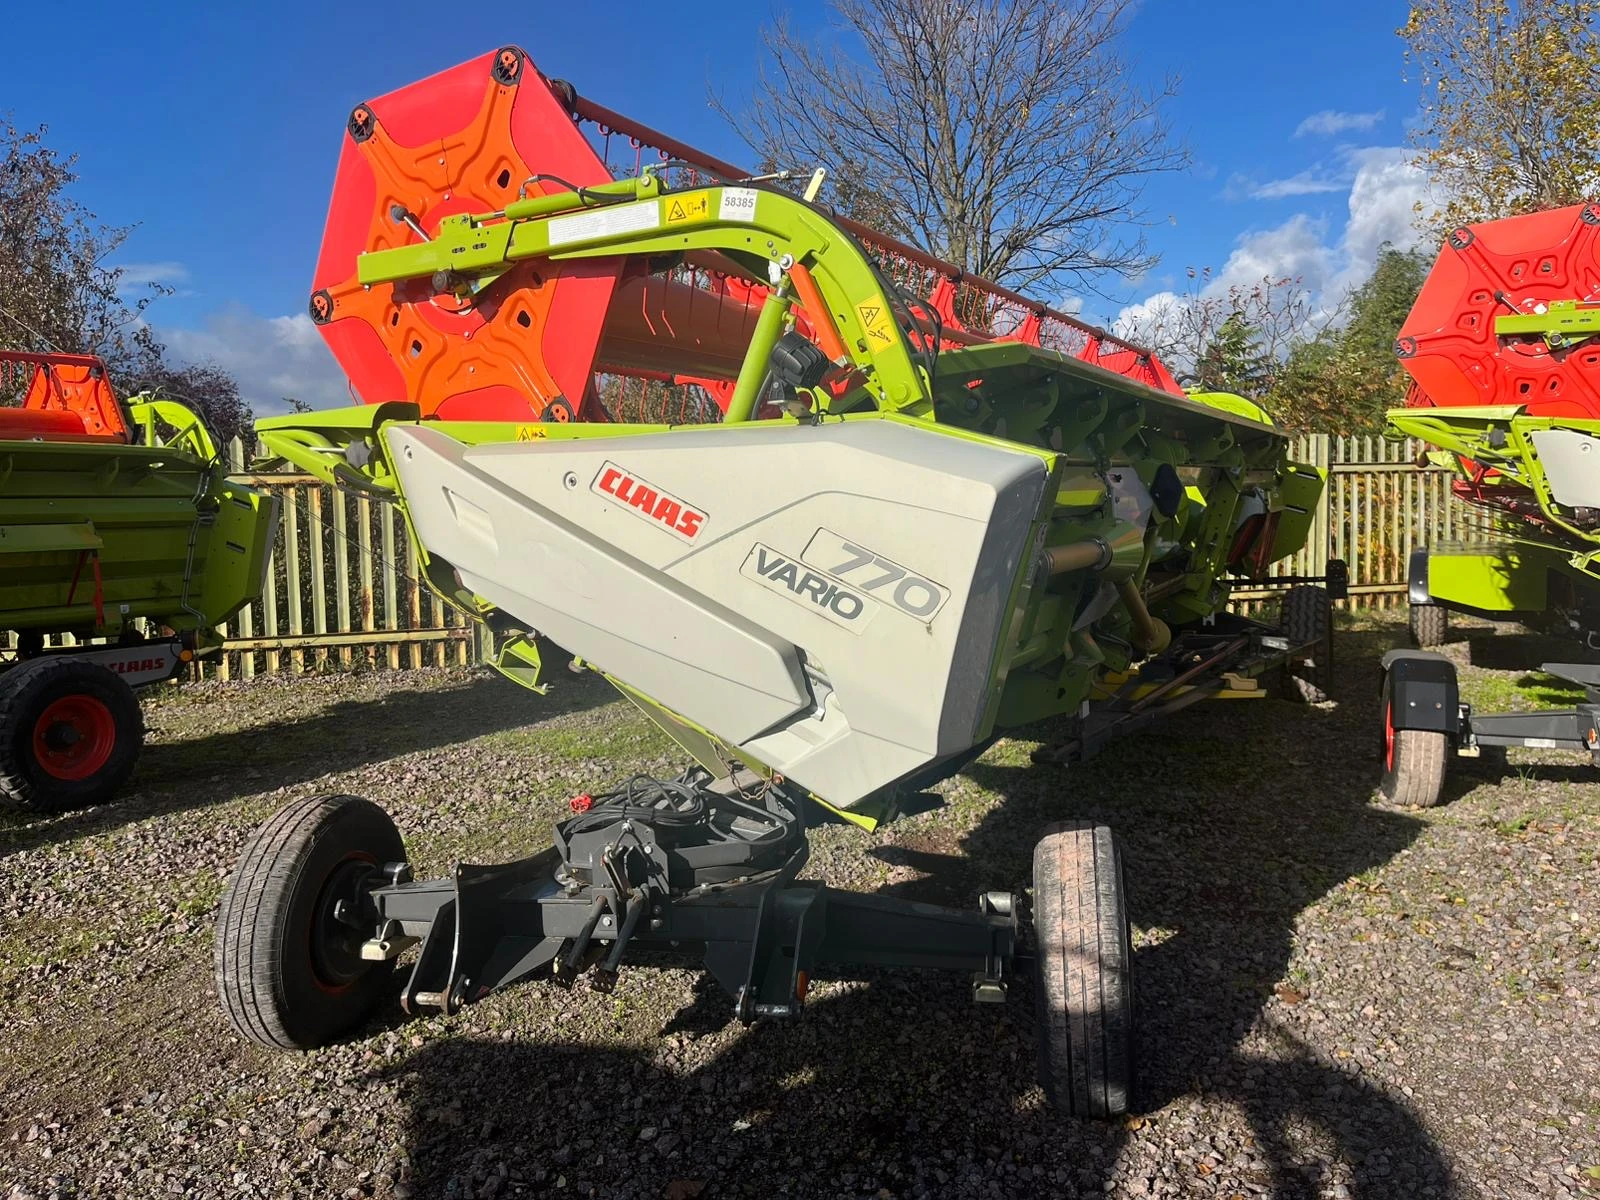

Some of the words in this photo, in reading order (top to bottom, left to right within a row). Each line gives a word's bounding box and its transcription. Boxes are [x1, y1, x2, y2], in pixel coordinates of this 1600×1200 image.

[724, 196, 754, 208] 58385
[599, 468, 704, 538] CLAAS
[756, 548, 864, 620] VARIO
[828, 542, 942, 617] 770
